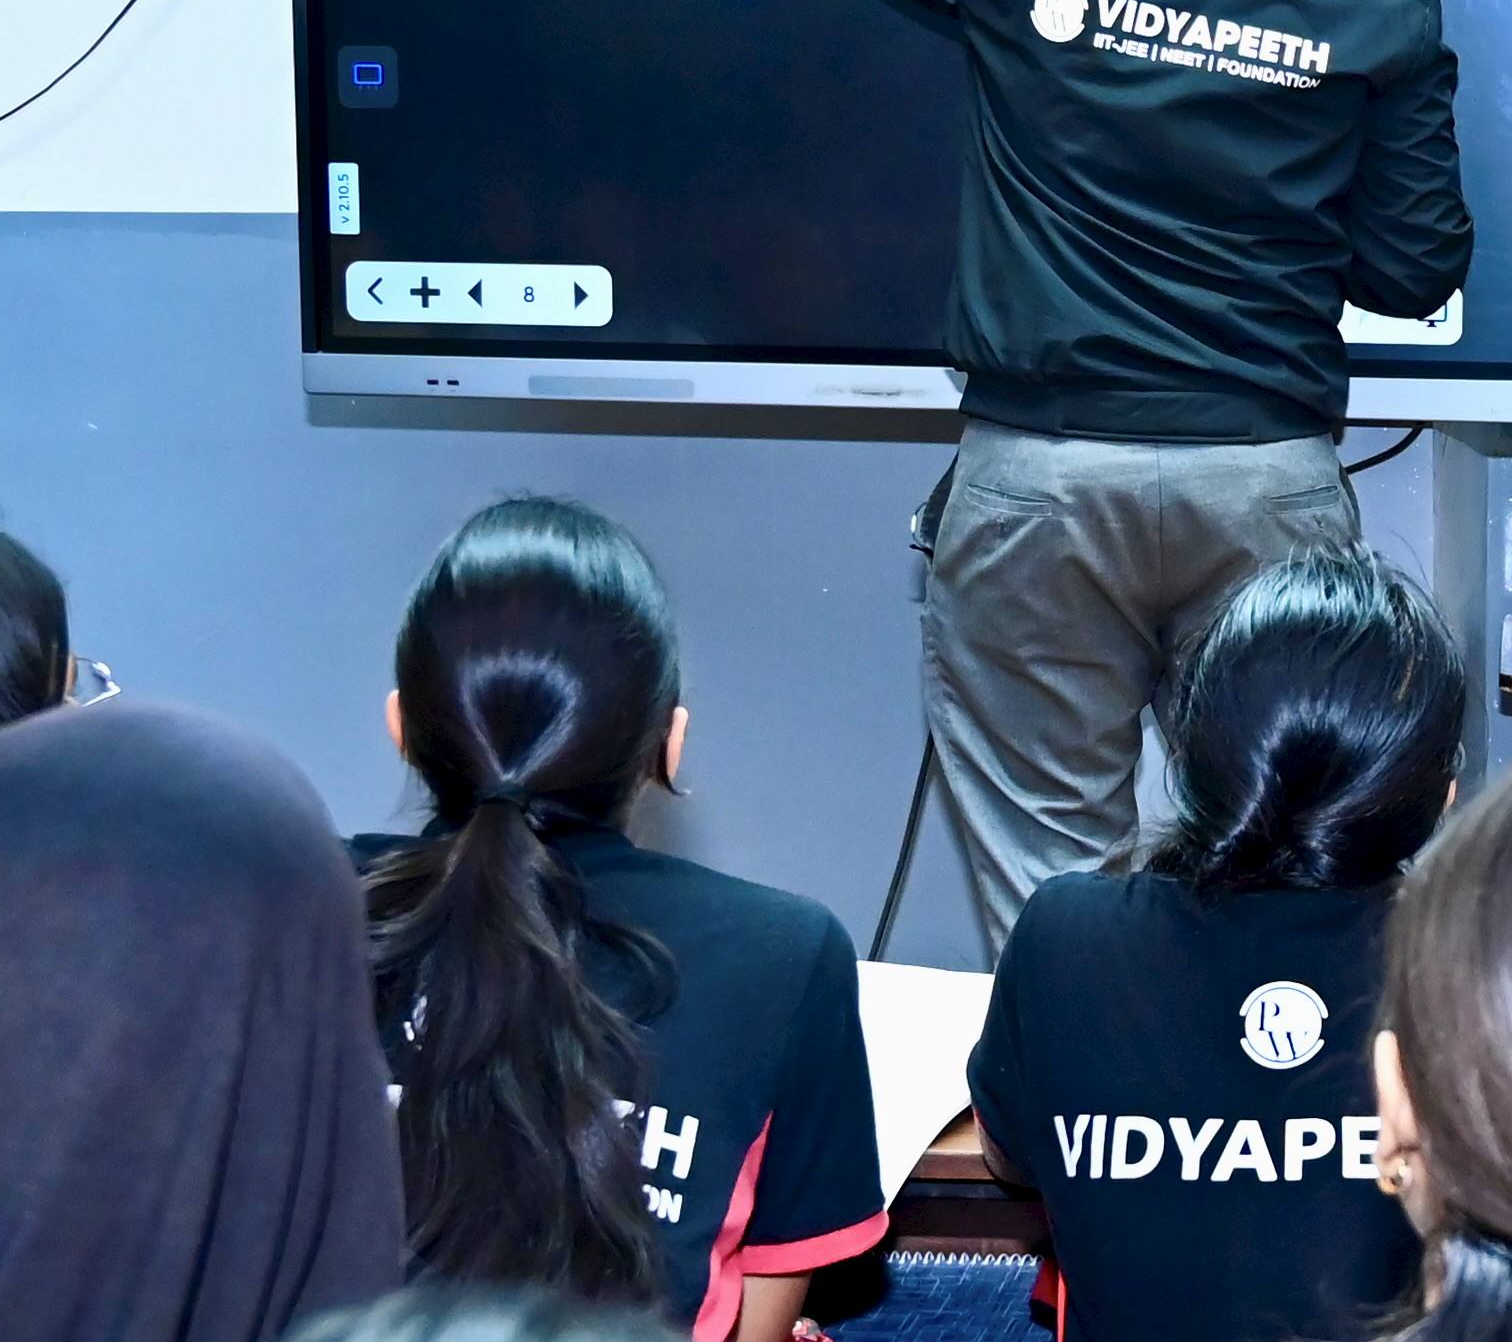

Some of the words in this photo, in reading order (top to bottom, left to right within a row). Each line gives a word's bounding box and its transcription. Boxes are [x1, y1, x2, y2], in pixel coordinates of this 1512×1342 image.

[1093, 32, 1149, 61] IIT-JEE
[1160, 47, 1206, 70] NEET
[1216, 58, 1321, 89] FOUNDATION
[523, 286, 535, 303] 8
